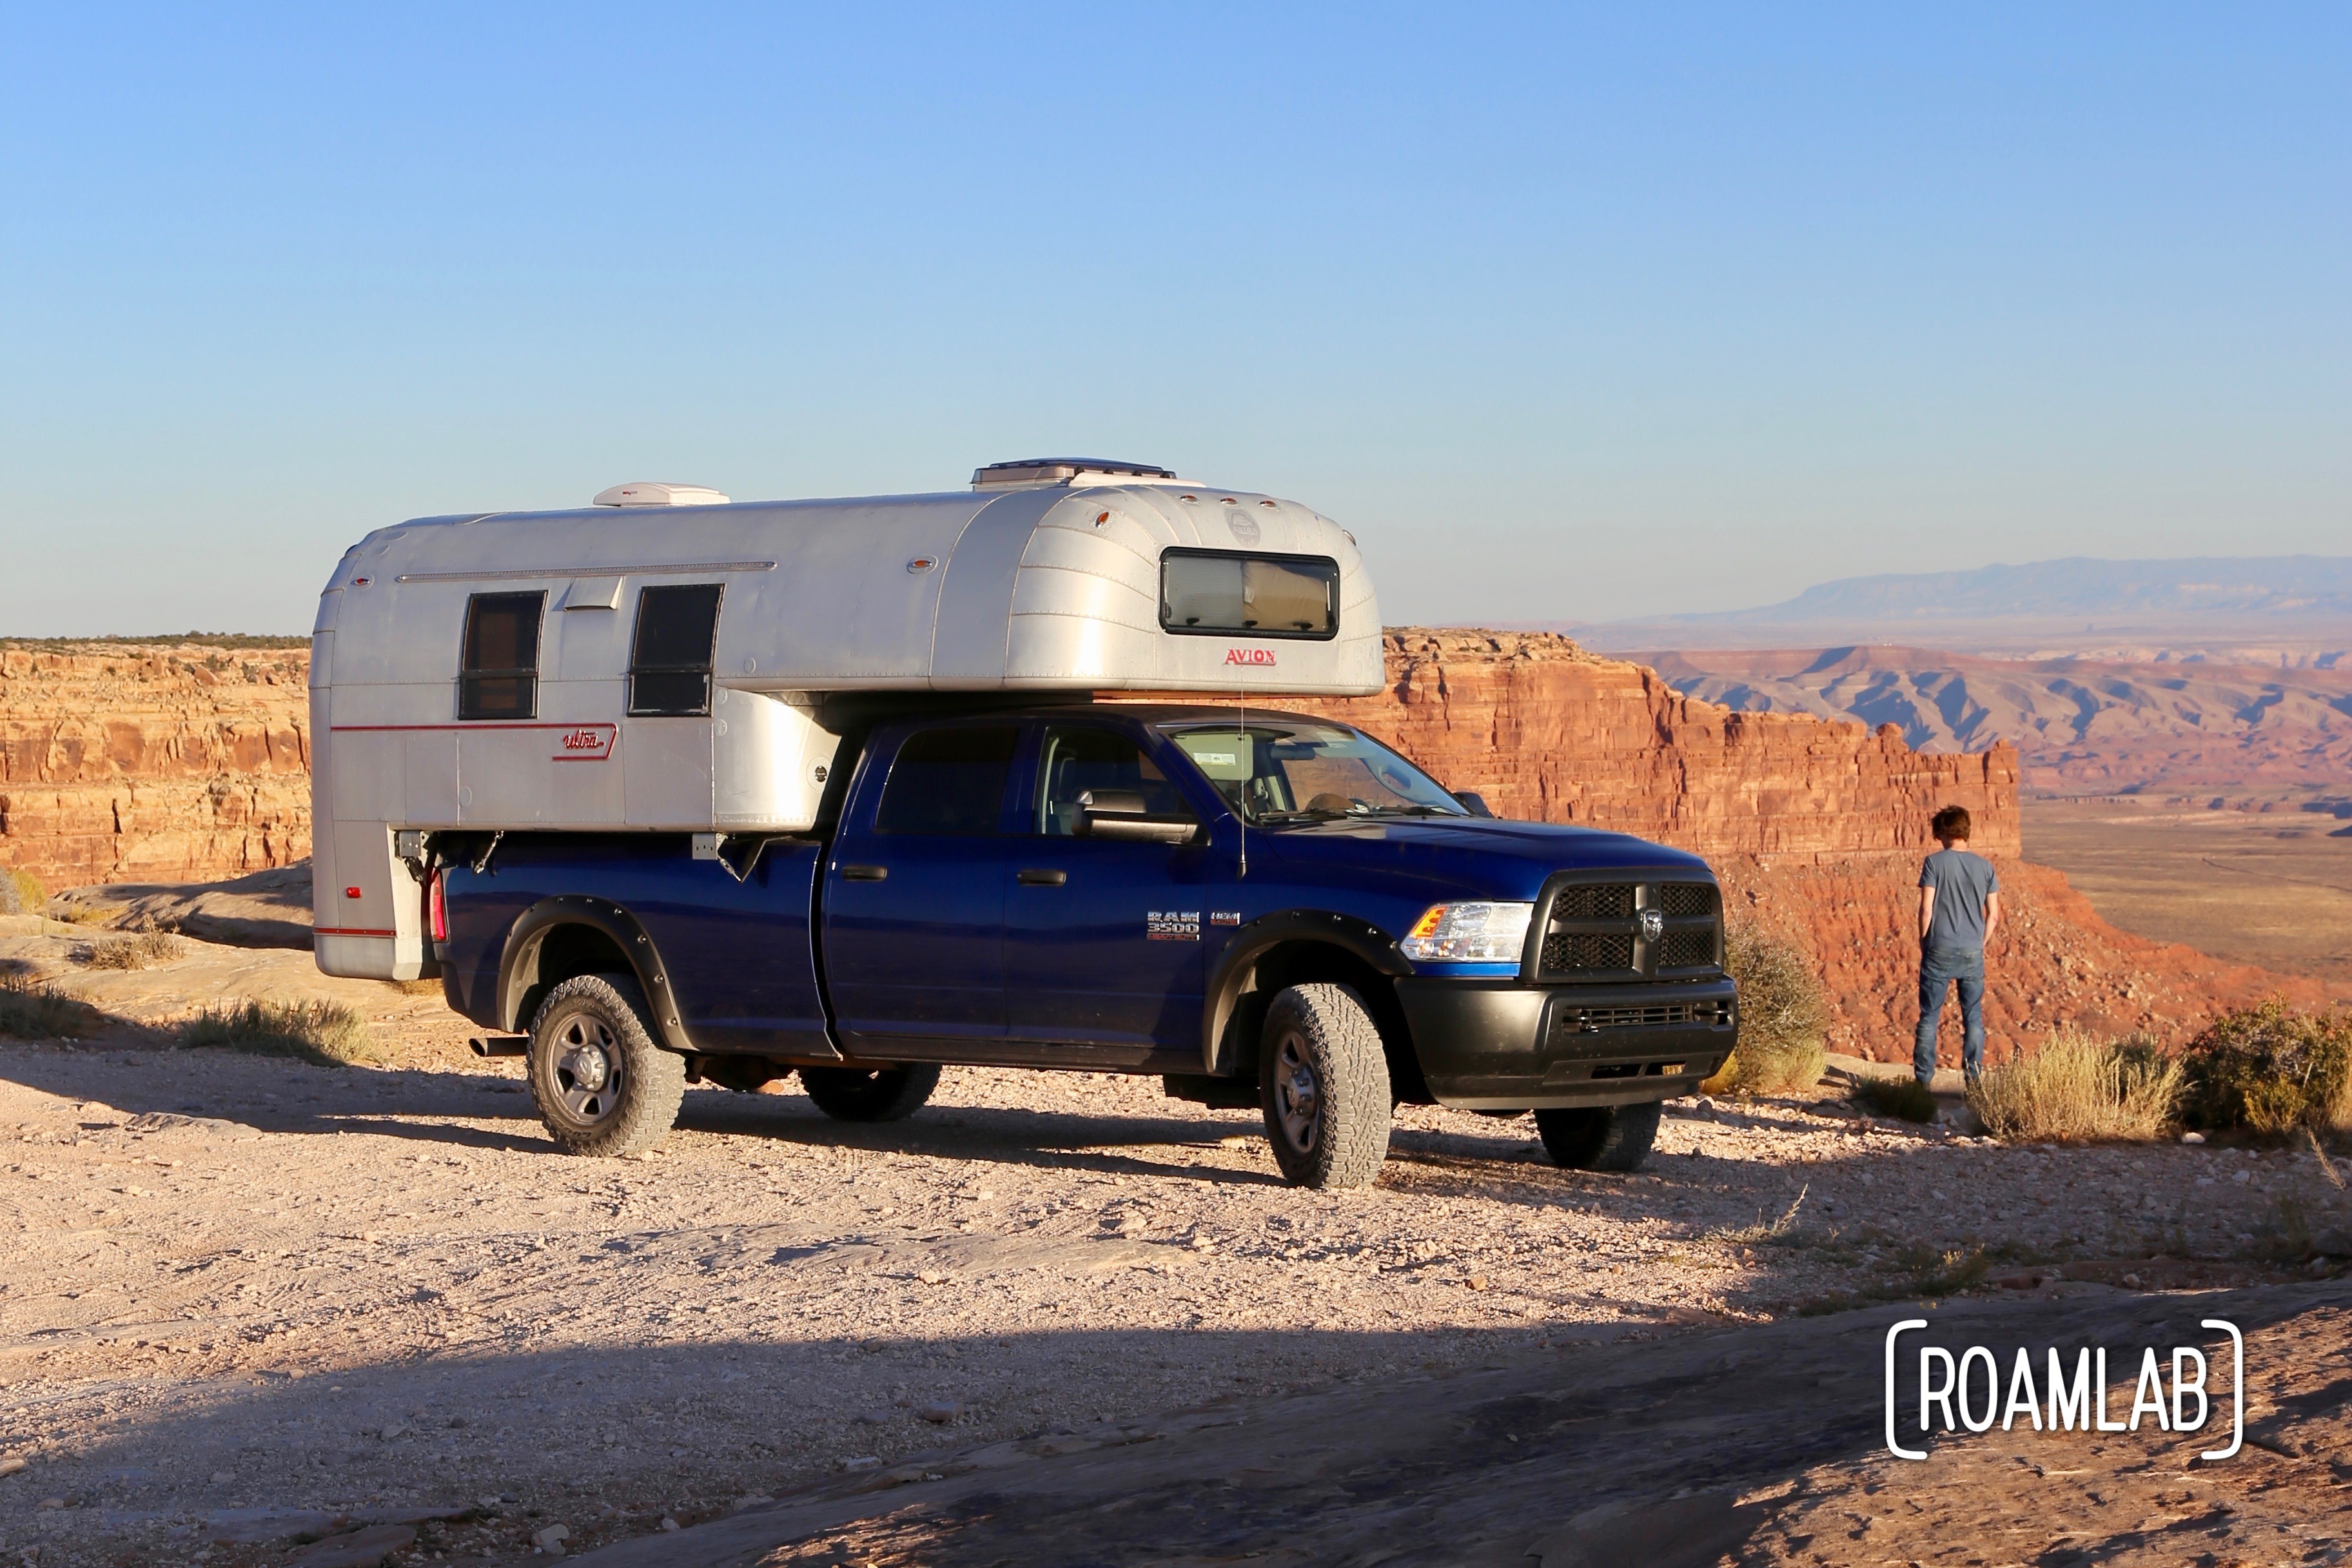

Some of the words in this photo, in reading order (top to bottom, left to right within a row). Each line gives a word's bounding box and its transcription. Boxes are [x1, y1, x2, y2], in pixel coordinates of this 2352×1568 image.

[1222, 649, 1277, 665] AVION
[1148, 911, 1199, 923] RAM
[1148, 922, 1199, 934] 3500
